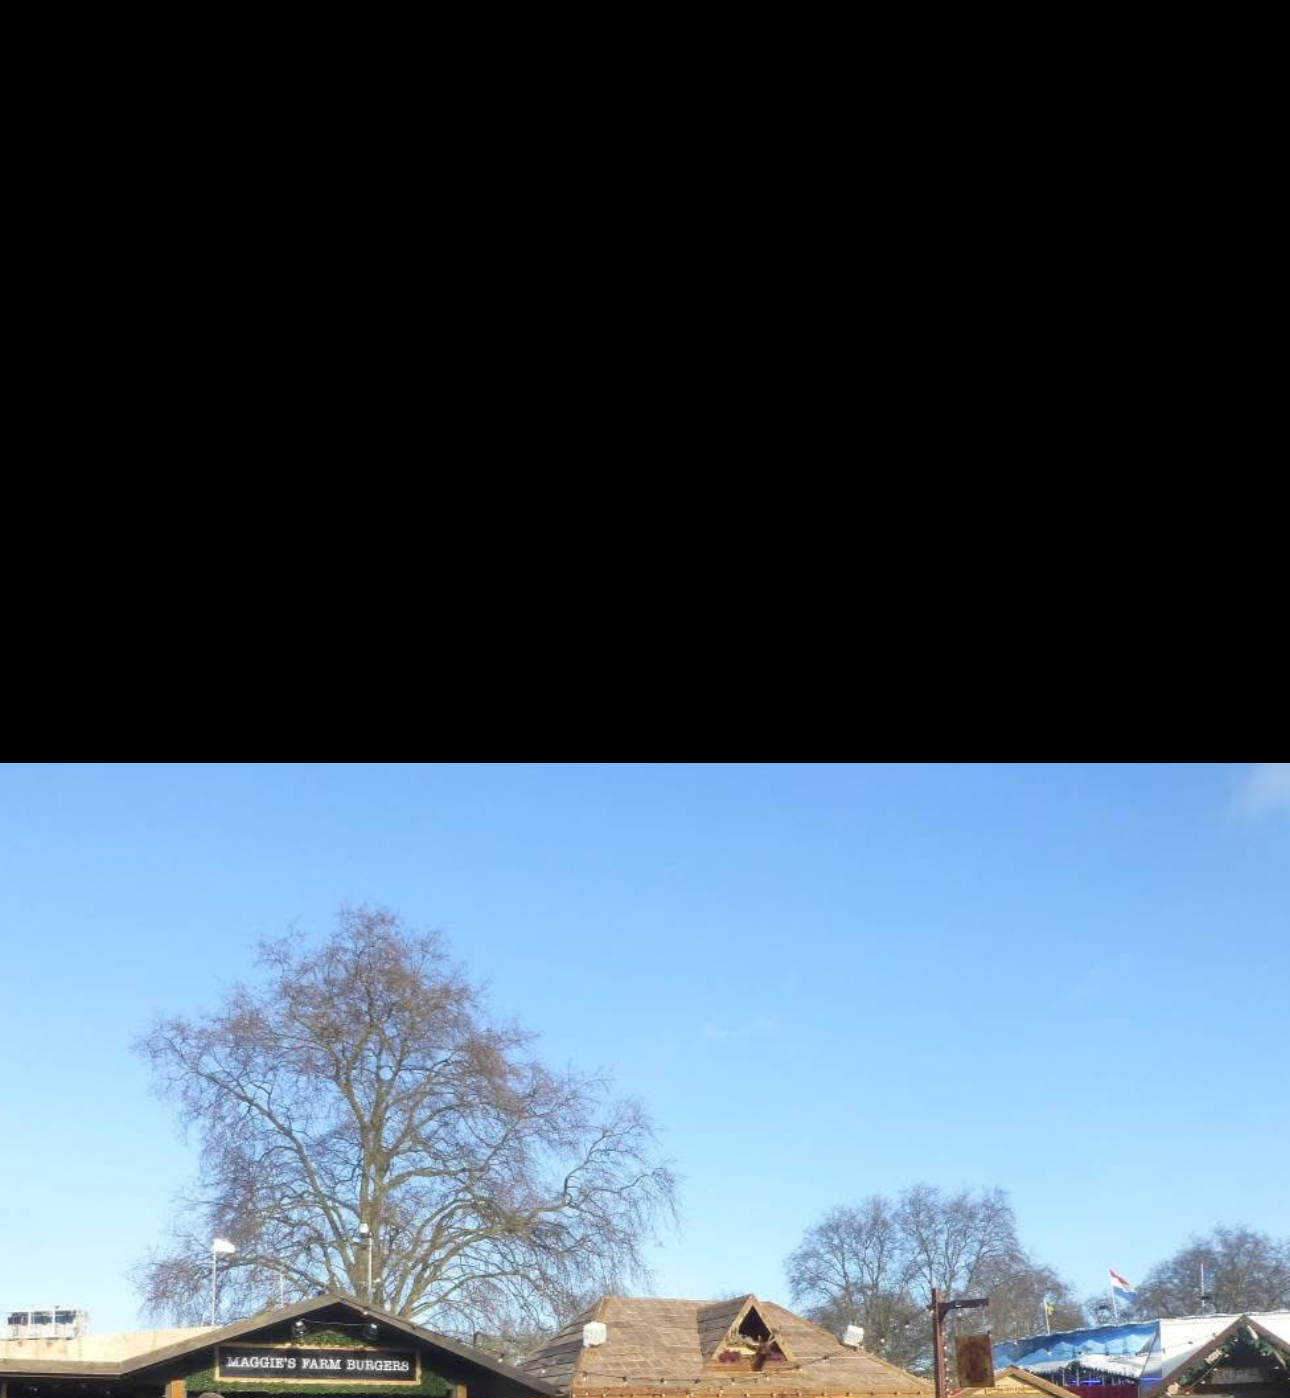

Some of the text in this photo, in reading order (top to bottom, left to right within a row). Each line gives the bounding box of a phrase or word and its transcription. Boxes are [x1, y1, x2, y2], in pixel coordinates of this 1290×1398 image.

[226, 1356, 410, 1371] MAGGIE'S FARM BURGERS
